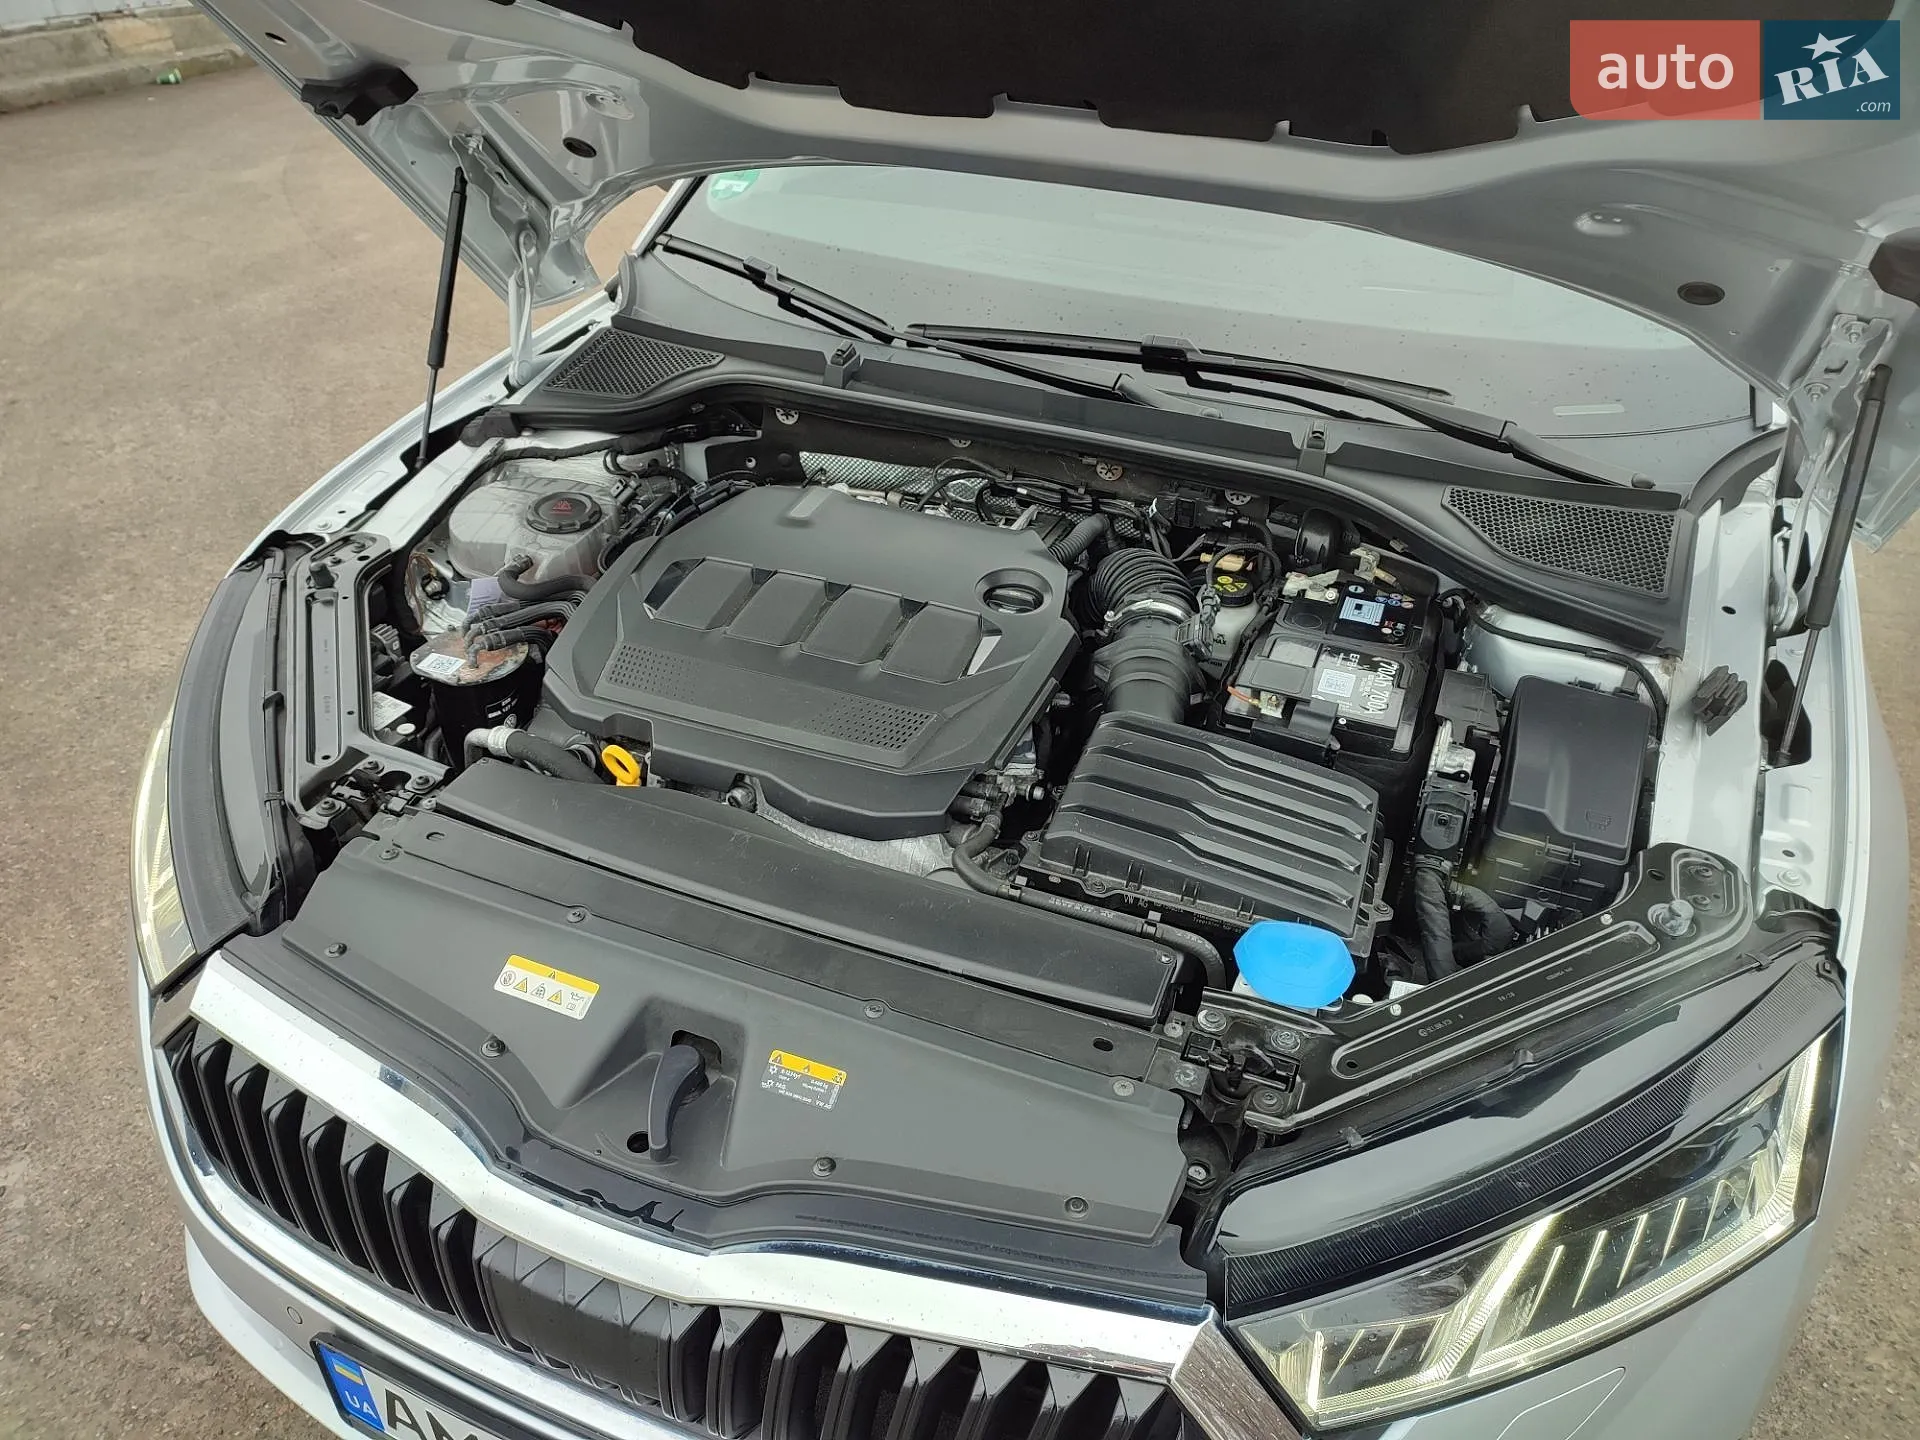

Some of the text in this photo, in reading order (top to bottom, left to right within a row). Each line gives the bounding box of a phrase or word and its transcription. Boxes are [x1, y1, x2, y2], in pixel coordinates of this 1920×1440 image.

[1374, 660, 1399, 688] 70Ah
[1364, 688, 1390, 714] 700A
[345, 1390, 377, 1419] UA
